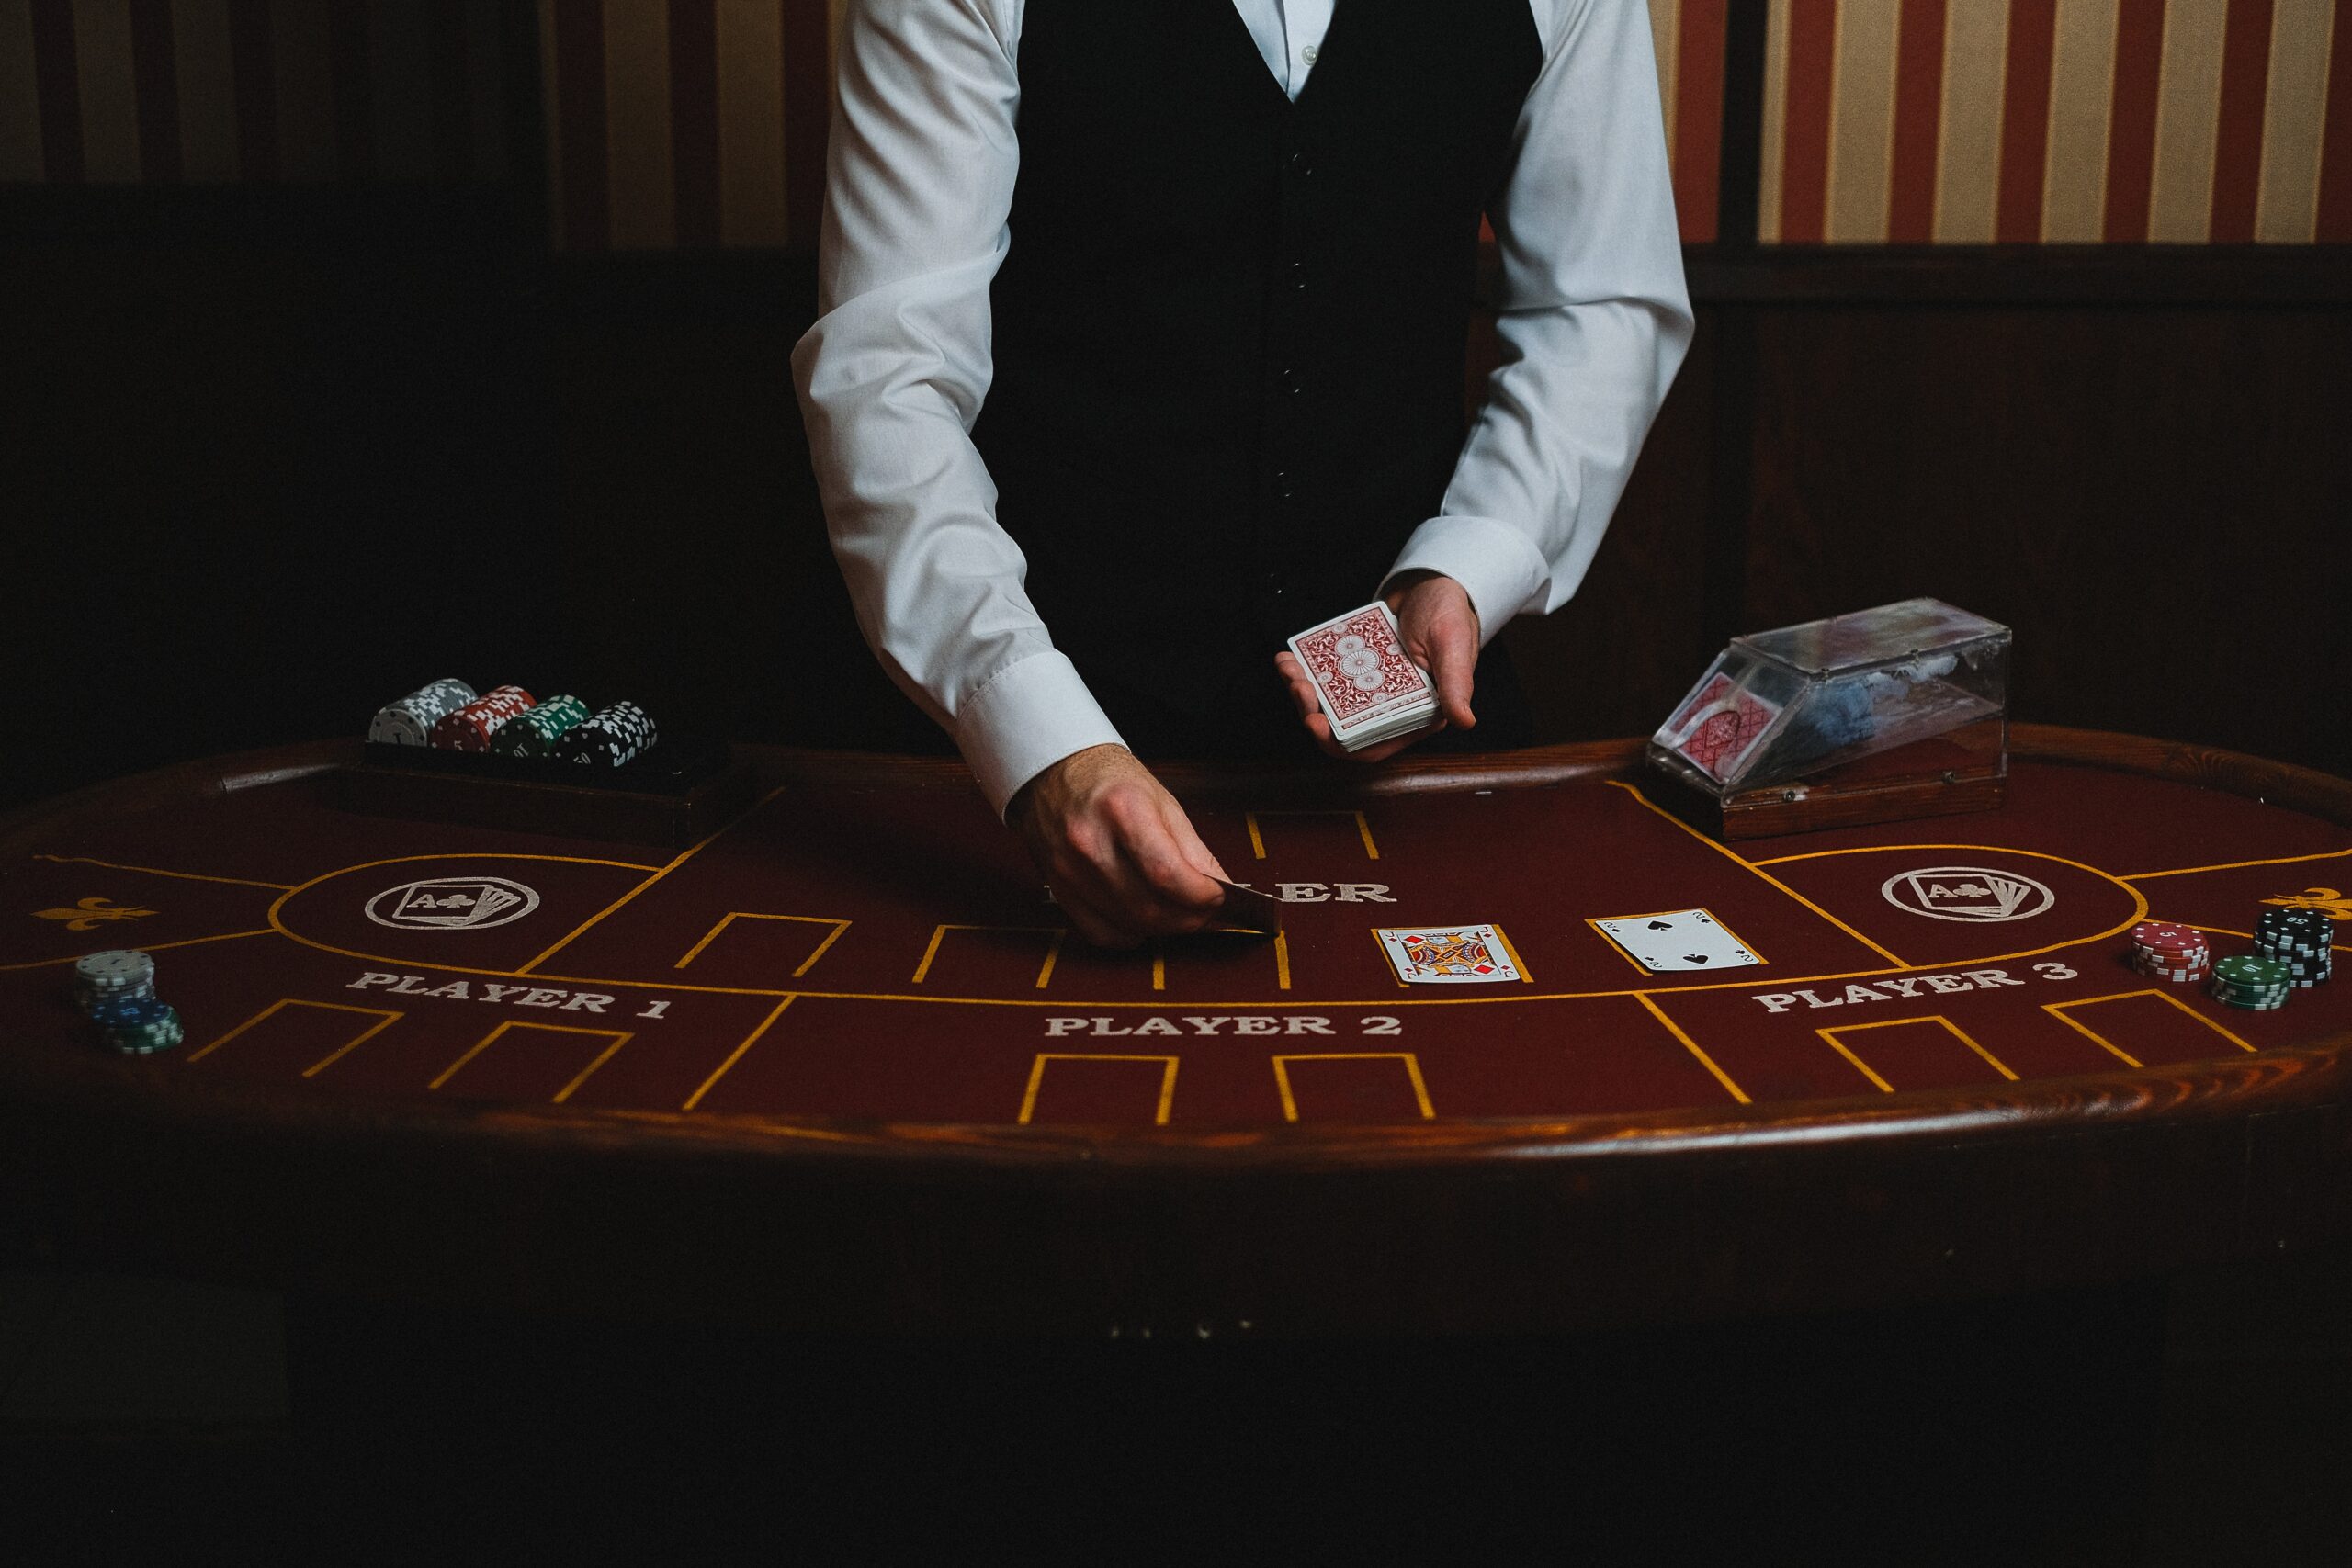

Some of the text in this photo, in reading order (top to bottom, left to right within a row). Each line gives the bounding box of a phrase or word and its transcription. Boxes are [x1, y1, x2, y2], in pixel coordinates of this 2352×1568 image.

[1928, 884, 1959, 898] A
[407, 894, 437, 908] A
[1692, 911, 1702, 919] 2
[2286, 916, 2309, 925] 50
[1743, 954, 1754, 963] 2
[1751, 963, 2078, 1013] PLAYER 3
[345, 972, 672, 1019] PLAYER 1
[1045, 1016, 1403, 1036] PLAYER 2
